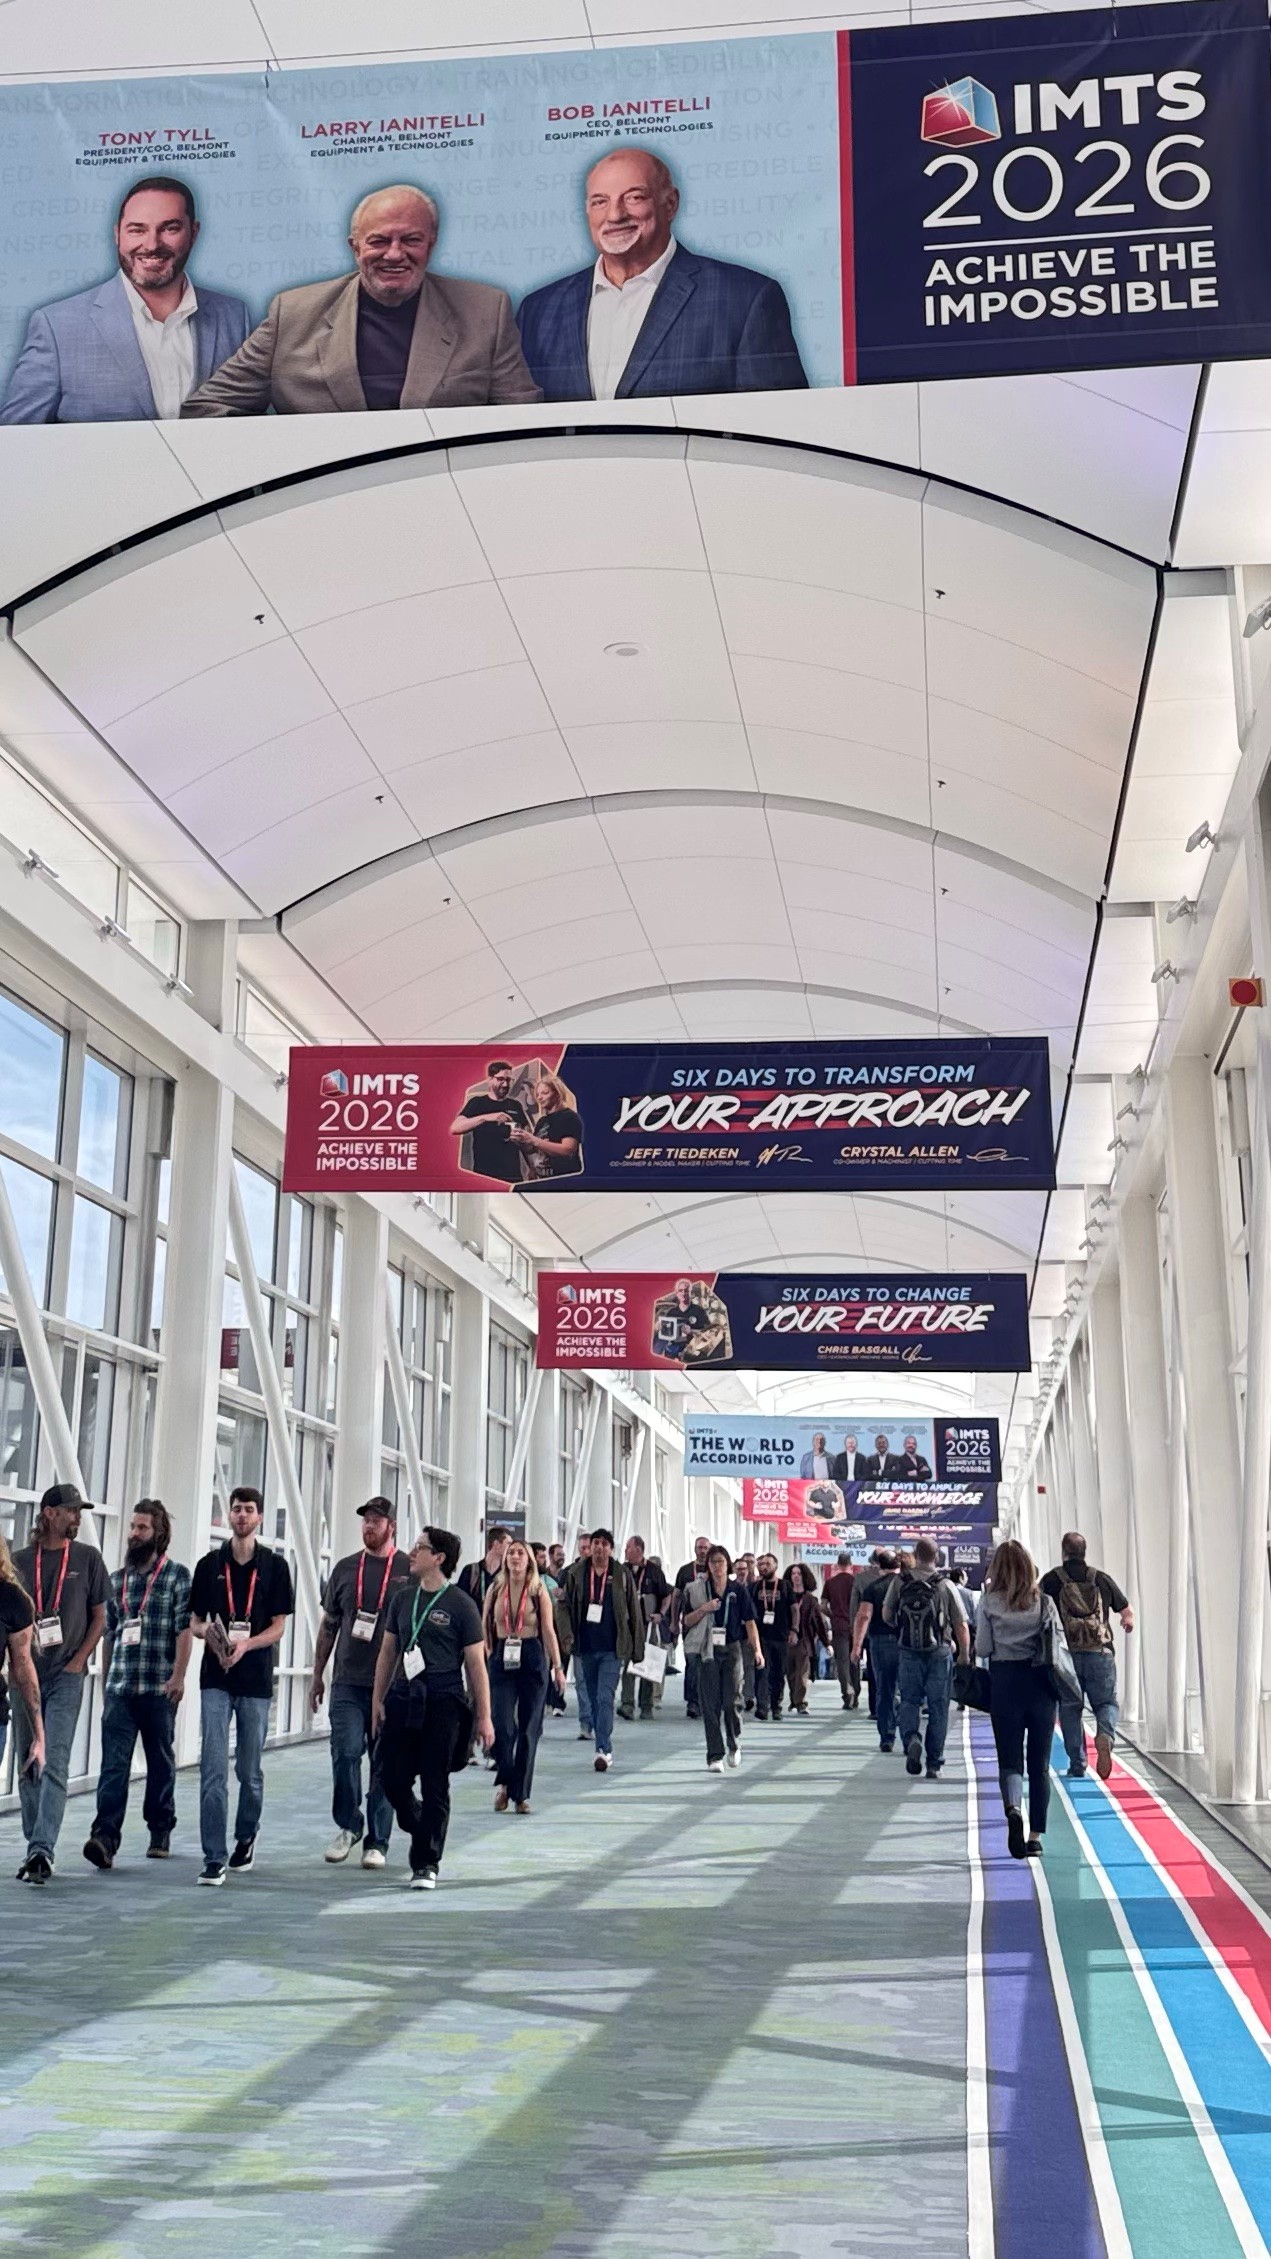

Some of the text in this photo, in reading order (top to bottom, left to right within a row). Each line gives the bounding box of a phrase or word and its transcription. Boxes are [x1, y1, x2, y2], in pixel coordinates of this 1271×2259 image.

[547, 105, 595, 121] BOB
[603, 97, 710, 117] IANITELLI
[1014, 70, 1206, 135] IMTS
[301, 120, 372, 139] LARRY
[381, 113, 484, 132] IANITELLI
[617, 116, 671, 126] BELMONT
[99, 130, 156, 146] TONY
[164, 128, 215, 142] TYLL
[545, 130, 610, 140] EQUIPMENT
[625, 122, 713, 135] TECHNOLOGIES
[177, 142, 229, 151] BELMONT
[333, 132, 452, 146] CHAIRMAN, BELMONT
[311, 146, 375, 157] EQUIPMENT
[388, 139, 474, 151] TECHNOLOGIES
[75, 156, 139, 166] EQUIPMENT
[152, 151, 236, 162] TECHNOLOGIES
[923, 134, 1211, 228] 2026
[925, 240, 1216, 287] ACHIEVE THE
[925, 276, 1219, 326] IMPOSSIBLE
[671, 1065, 975, 1087] SIX DAYS TO TRANSFORM
[352, 1074, 420, 1095] IMTS
[318, 1100, 419, 1131] 2026
[613, 1089, 1030, 1133] YOUR APPROACH
[317, 1142, 418, 1155] ACHIEVE THE
[625, 1147, 740, 1159] JEFF TIEDEKEN
[840, 1146, 906, 1158] CRYSTAL
[909, 1145, 960, 1157] ALLEN
[316, 1157, 418, 1170] IMPOSSIBLE
[579, 1288, 626, 1304] IMTS
[781, 1287, 971, 1301] SIX DAYS TO CHANGE
[556, 1306, 626, 1329] 2026
[755, 1304, 995, 1333] YOUR FUTURE
[556, 1337, 626, 1346] ACHIEVE THE
[556, 1347, 626, 1357] IMPOSSIBLE
[817, 1346, 849, 1354] CHRIS
[851, 1346, 900, 1354] BASGALL
[959, 1429, 990, 1440] IMTS
[690, 1437, 724, 1450] THE
[946, 1440, 991, 1456] 2026
[690, 1452, 794, 1465] ACCORDING TO
[916, 1483, 928, 1491] TO
[753, 1489, 789, 1501] 2026
[856, 1491, 983, 1505] YOUR KNOWLEDGE
